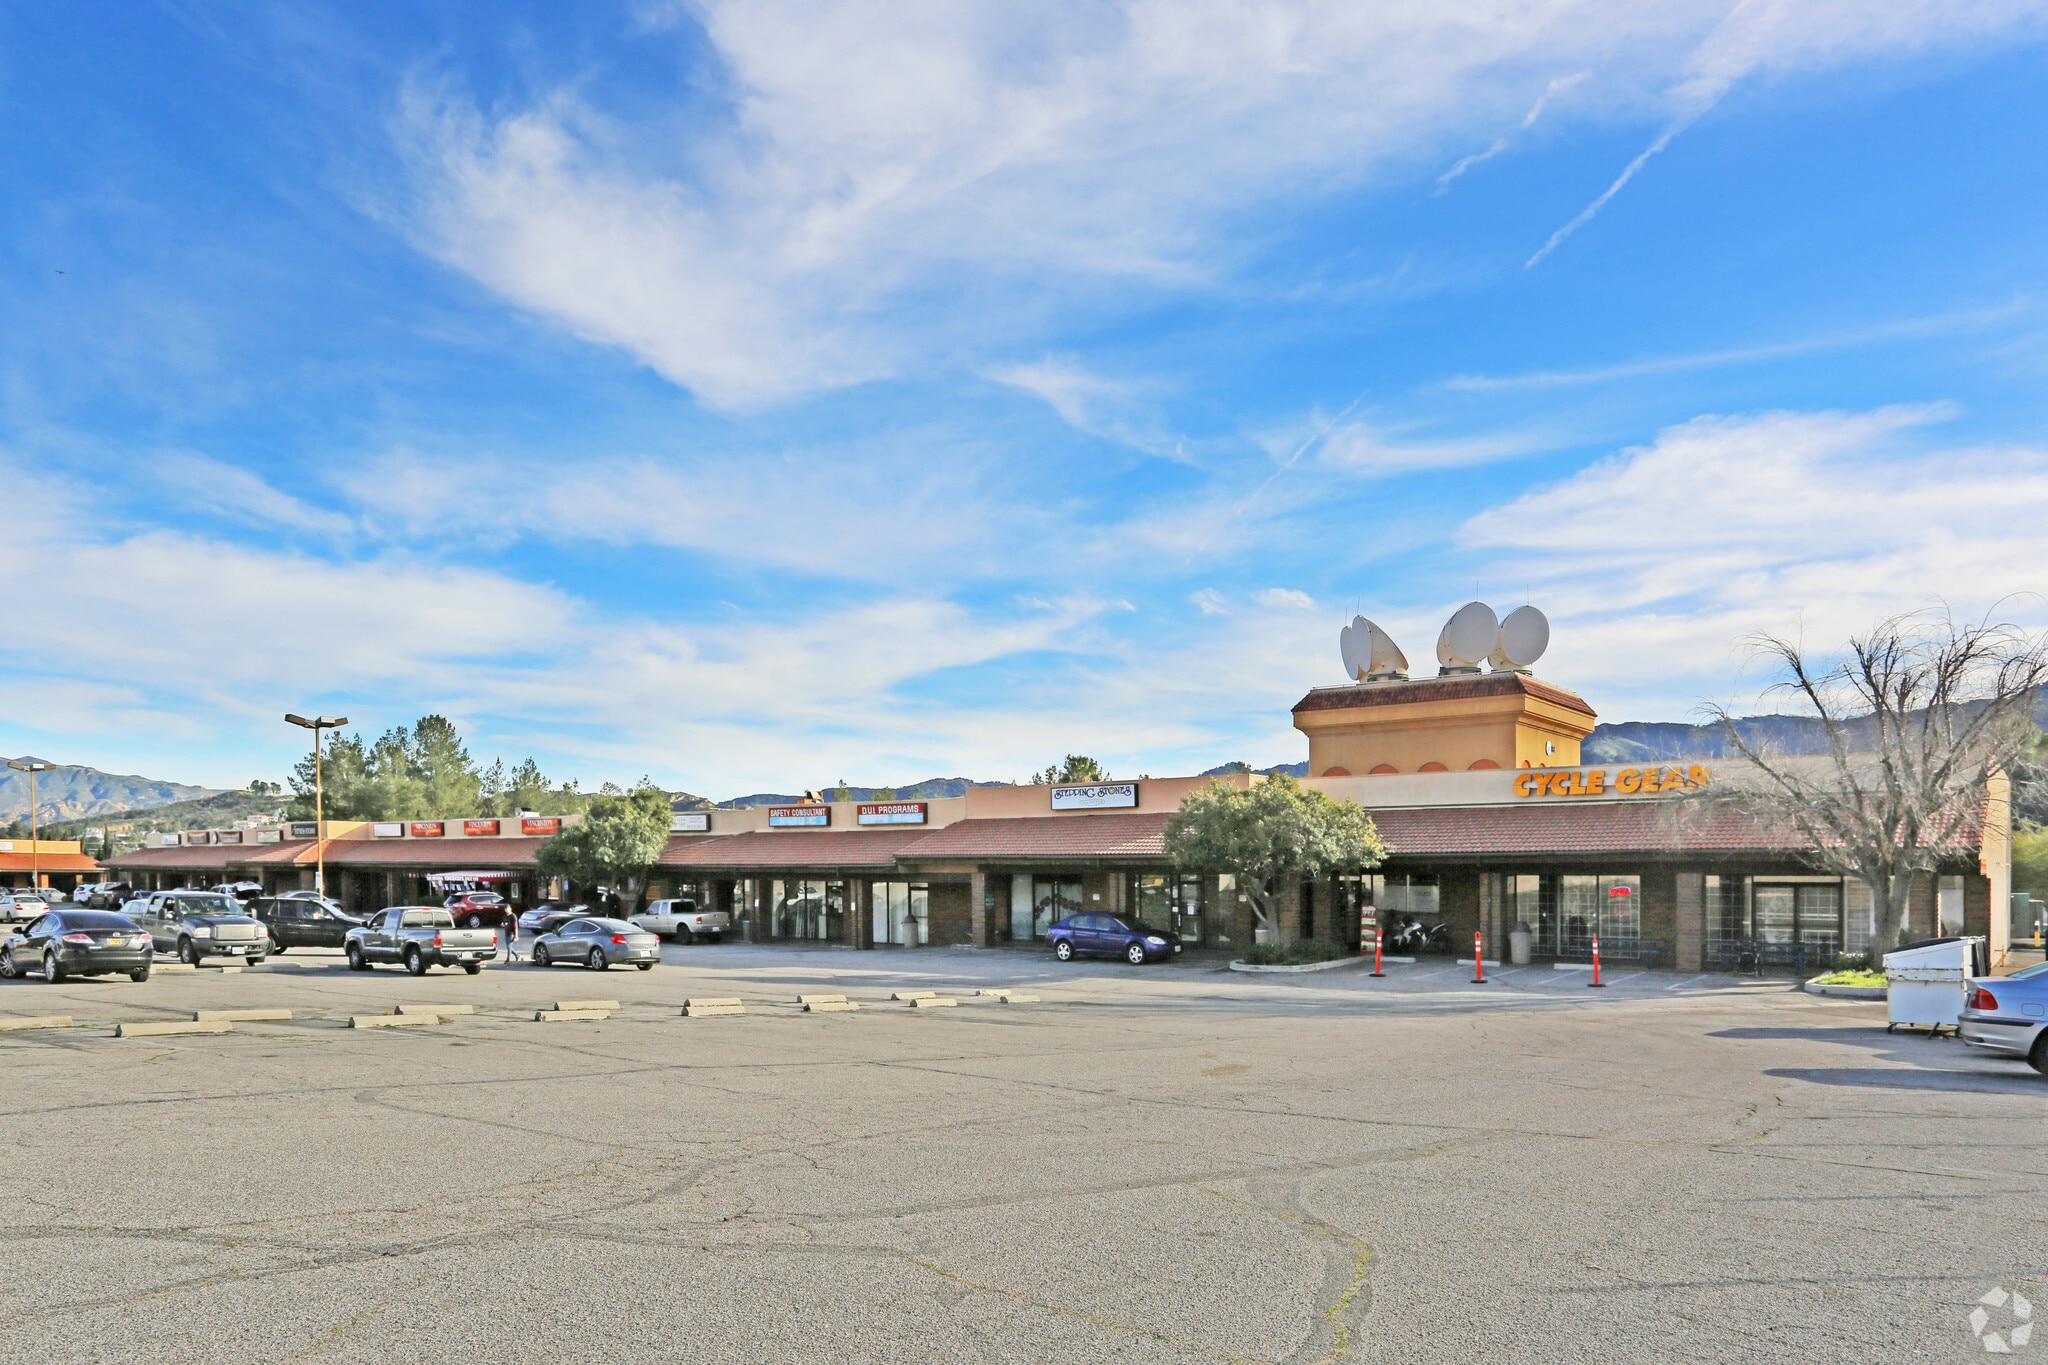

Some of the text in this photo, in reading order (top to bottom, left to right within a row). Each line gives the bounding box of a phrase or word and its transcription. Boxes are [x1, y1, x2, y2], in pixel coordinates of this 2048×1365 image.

[1513, 765, 1711, 797] CYCLE GEAR
[1054, 785, 1132, 800] STEPPING STONES
[770, 808, 826, 817] SAFETY CONSULTANT
[878, 804, 919, 814] PROGRAMS
